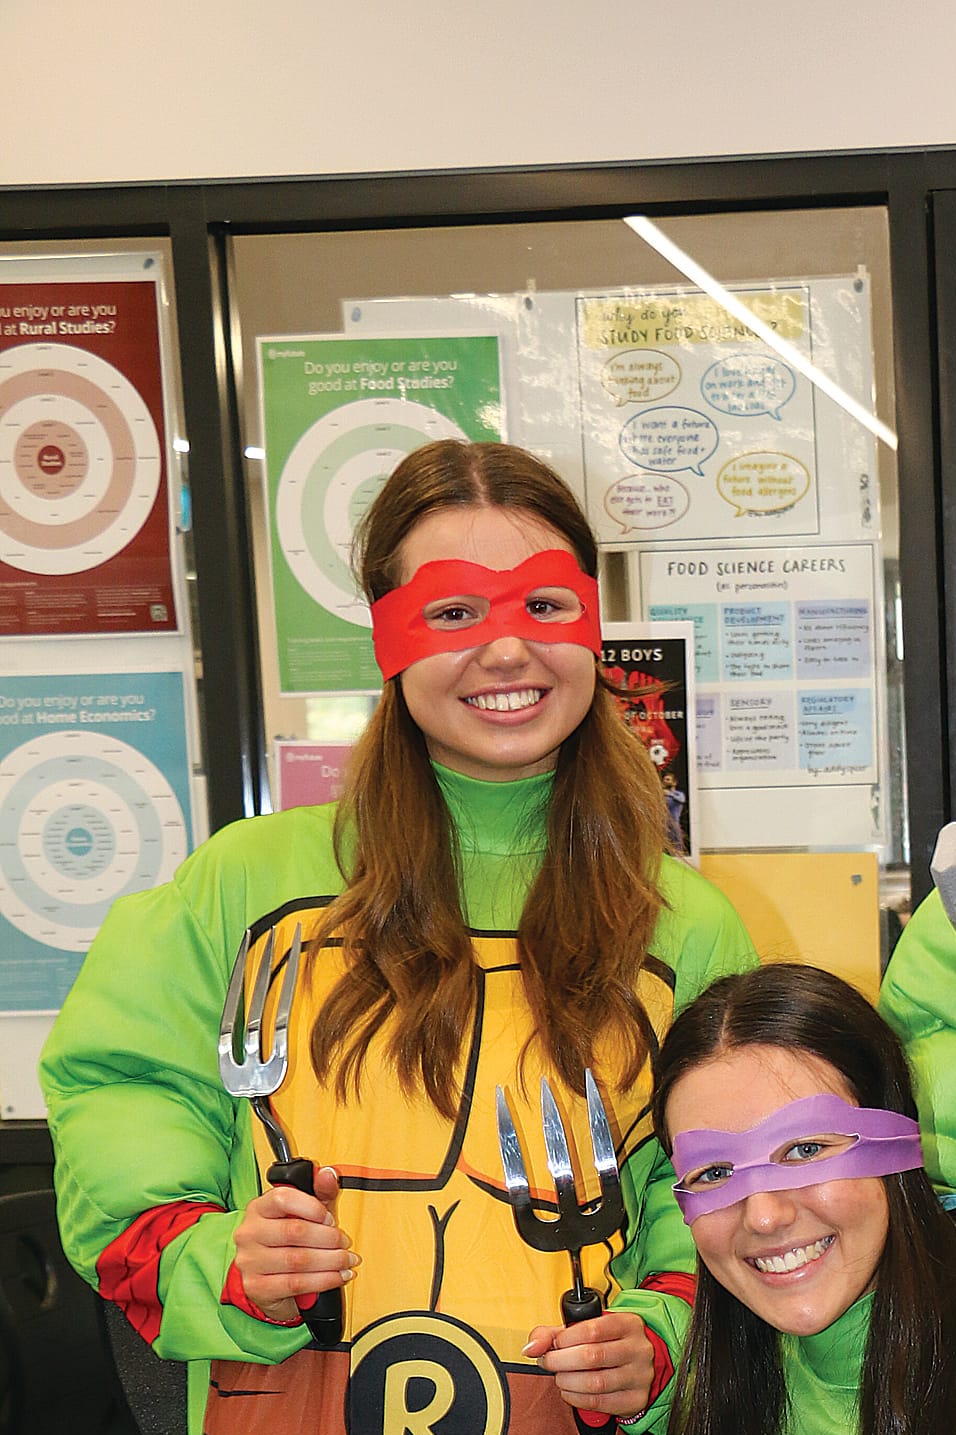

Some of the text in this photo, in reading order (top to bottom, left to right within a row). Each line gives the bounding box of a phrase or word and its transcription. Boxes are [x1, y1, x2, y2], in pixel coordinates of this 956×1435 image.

[13, 305, 49, 320] enjoy
[50, 306, 64, 316] or
[68, 306, 91, 316] are
[89, 305, 117, 319] you
[640, 309, 657, 321] do
[4, 324, 18, 336] at
[19, 321, 57, 335] Rural
[58, 320, 116, 335] Studies?
[600, 328, 649, 345] STUDY
[655, 326, 694, 342] FOOD
[304, 360, 457, 377] Do you enjoy or are you
[628, 362, 664, 376] always
[647, 374, 677, 385] about
[308, 376, 454, 396] good at Food Studies?
[641, 420, 667, 430] want
[671, 421, 678, 429] a
[652, 446, 673, 455] safe
[779, 463, 788, 471] a
[757, 475, 794, 485] without
[731, 486, 753, 497] food
[657, 496, 674, 505] EAT
[667, 558, 847, 576] FOOD SCIENCE CAREERS
[650, 608, 688, 617] QUALITY
[723, 607, 761, 616] PRODUCT
[799, 606, 869, 616] MANUFACTURING
[723, 614, 785, 624] DEVELOPMENT
[601, 648, 664, 662] 12 BOYS
[0, 694, 145, 711] Do you enjoy or are you
[730, 699, 773, 707] SENSORY
[801, 695, 855, 704] REGULATORY
[803, 704, 837, 713] AFFAIRS
[0, 708, 156, 725] od at Home Economics?
[639, 710, 684, 720] OCTOBER
